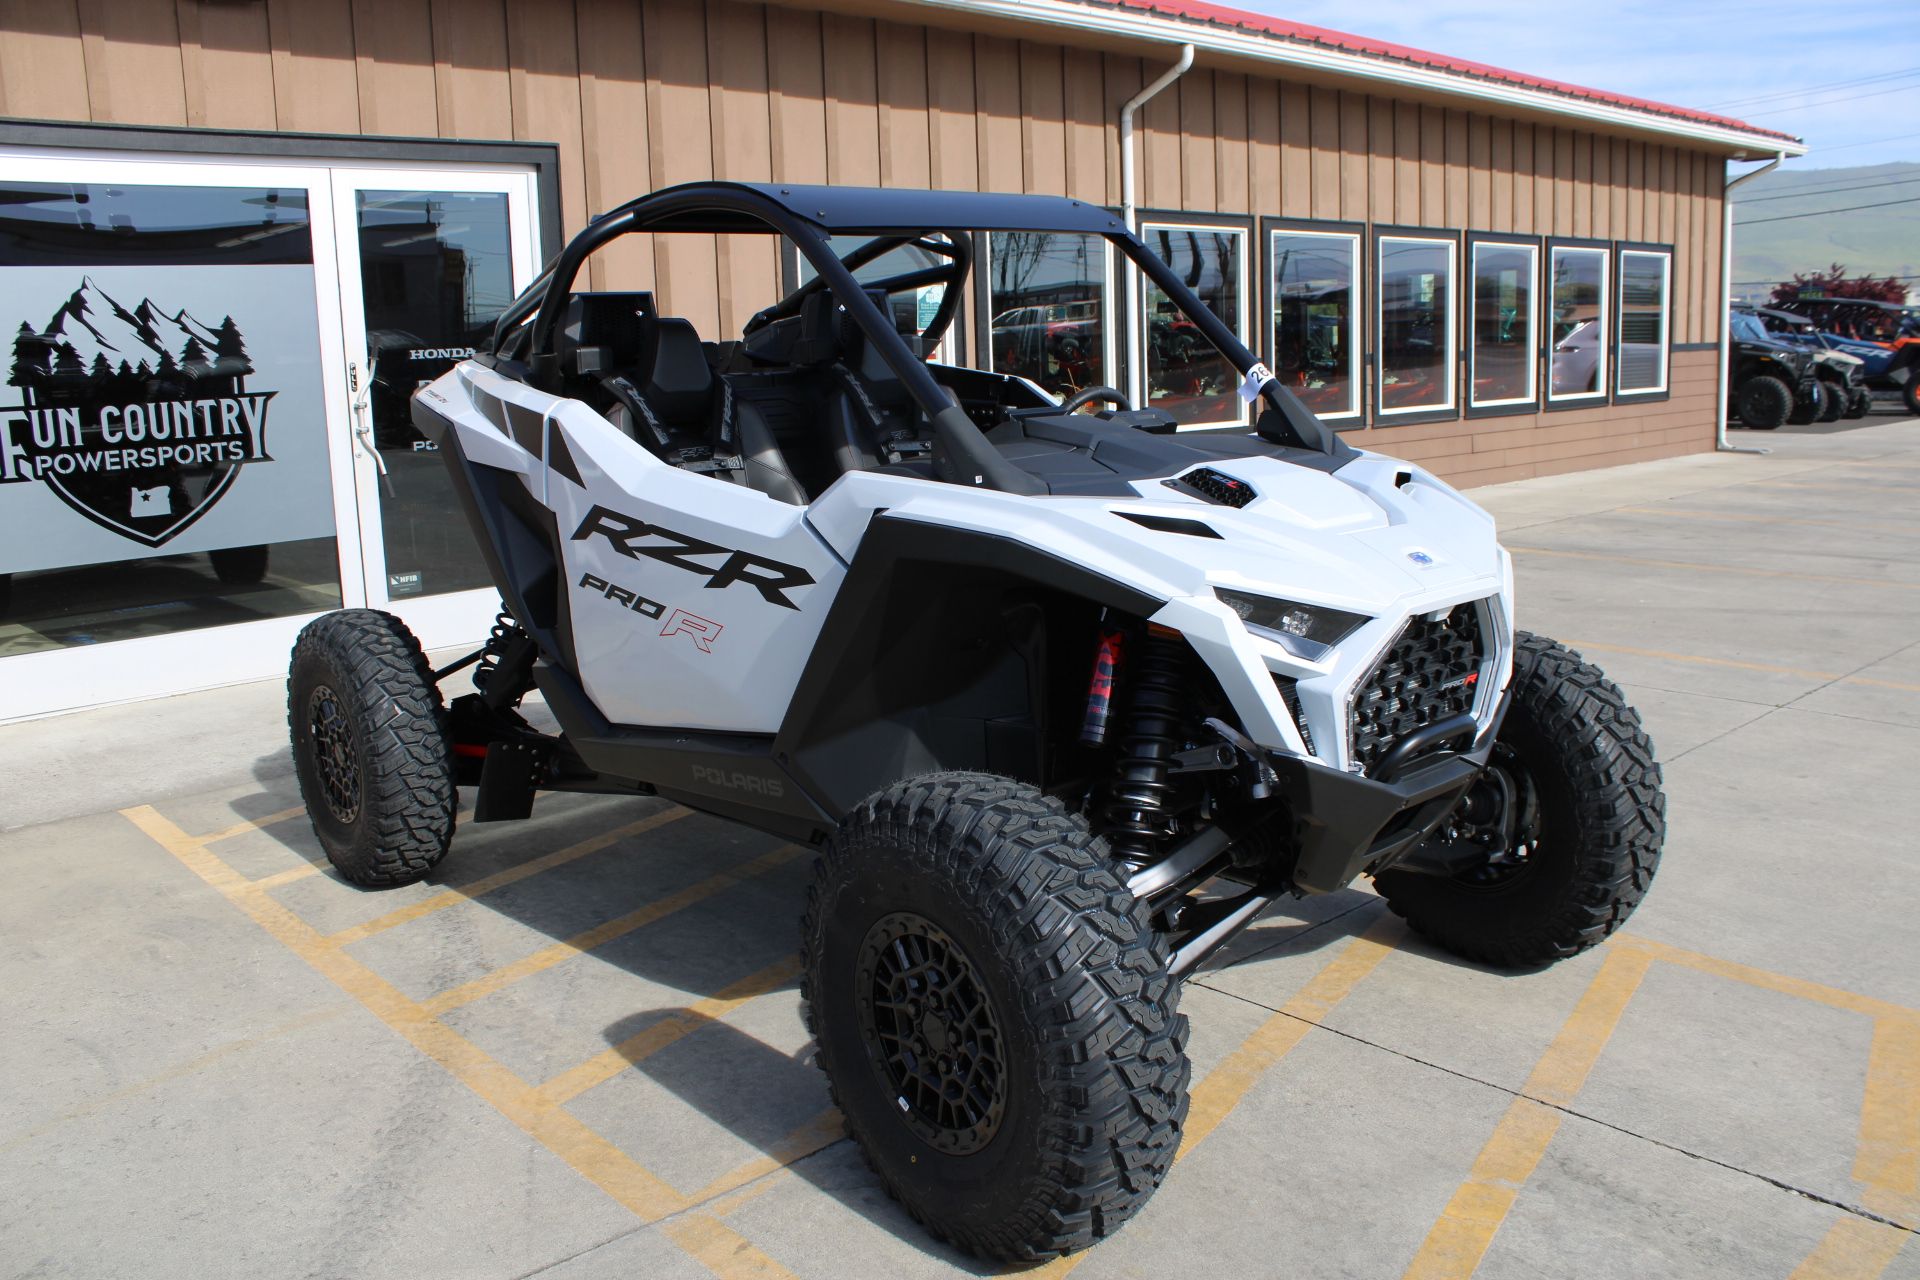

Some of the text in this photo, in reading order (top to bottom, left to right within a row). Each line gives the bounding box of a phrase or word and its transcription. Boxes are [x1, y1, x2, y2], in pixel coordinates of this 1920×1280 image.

[409, 347, 476, 360] HONDA
[0, 396, 267, 480] FUN COUNTRY
[34, 440, 245, 476] POWERSPORTS
[570, 504, 817, 612] RZR
[692, 765, 784, 797] POLARIS
